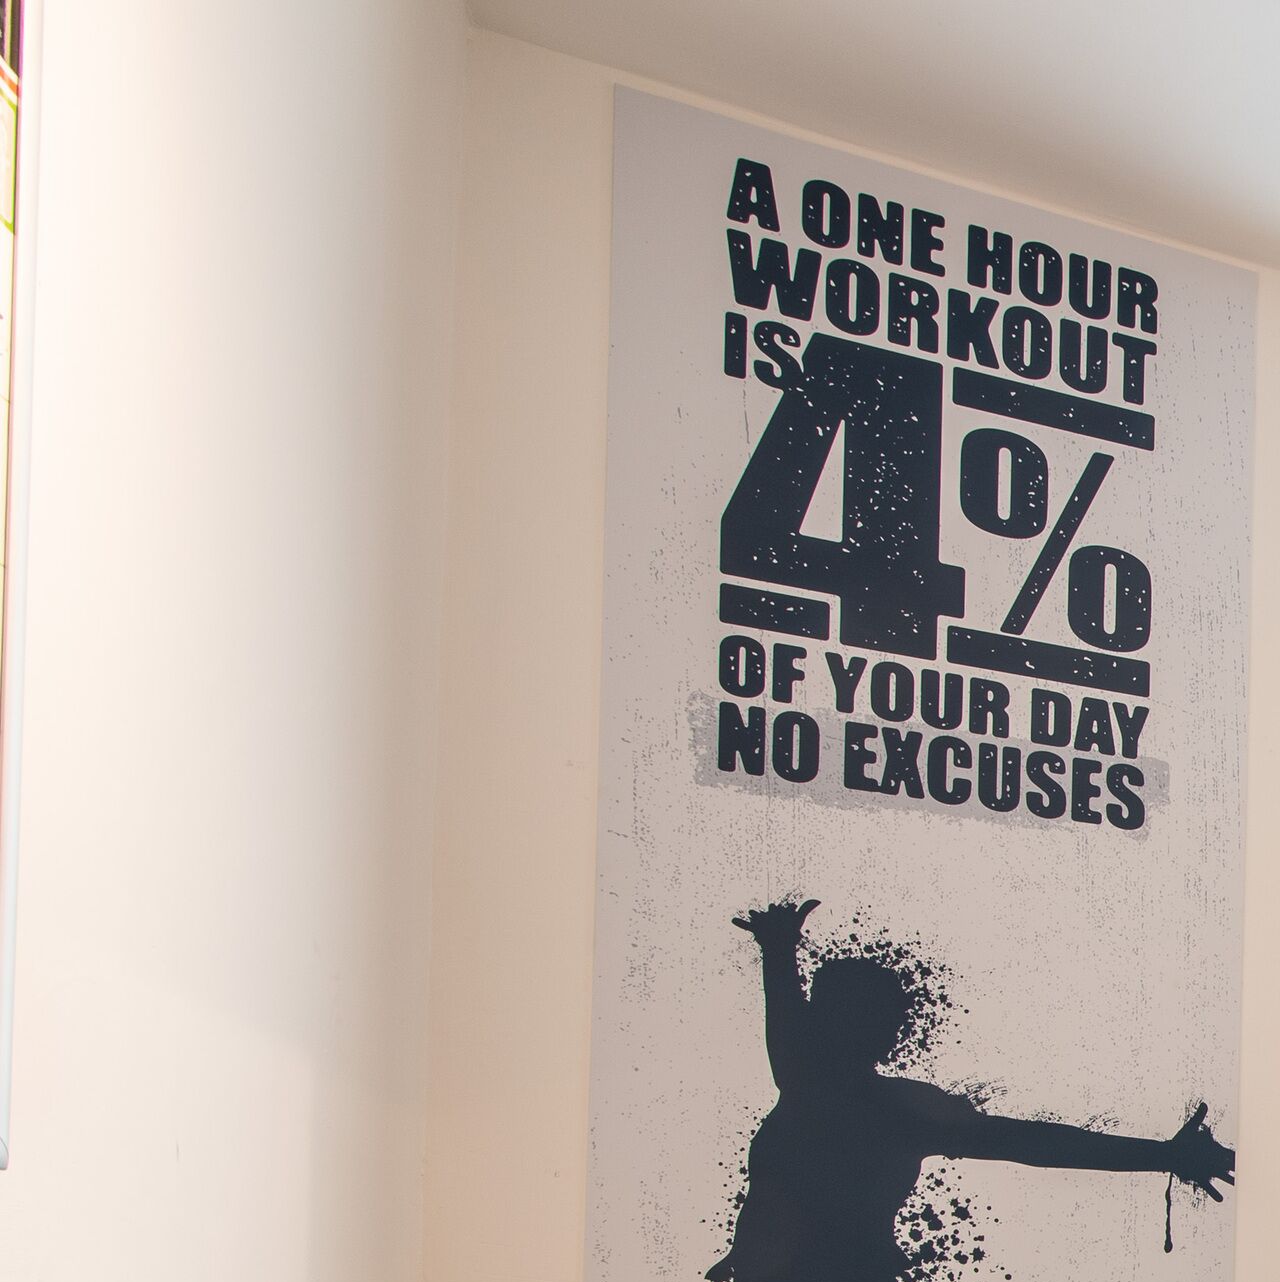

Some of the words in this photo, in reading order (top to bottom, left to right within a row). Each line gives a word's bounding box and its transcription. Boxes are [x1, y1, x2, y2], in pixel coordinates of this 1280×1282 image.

[725, 228, 1157, 405] WORKOUT
[726, 157, 780, 232] A
[800, 178, 946, 277] ONE
[966, 224, 1158, 334] HOUR
[723, 311, 802, 392] IS
[719, 332, 1152, 661] 4%
[717, 702, 820, 783] NO
[843, 721, 1146, 830] EXCUSES
[718, 634, 807, 704] OF
[825, 652, 1010, 738] YOUR
[1030, 687, 1150, 759] DAY
